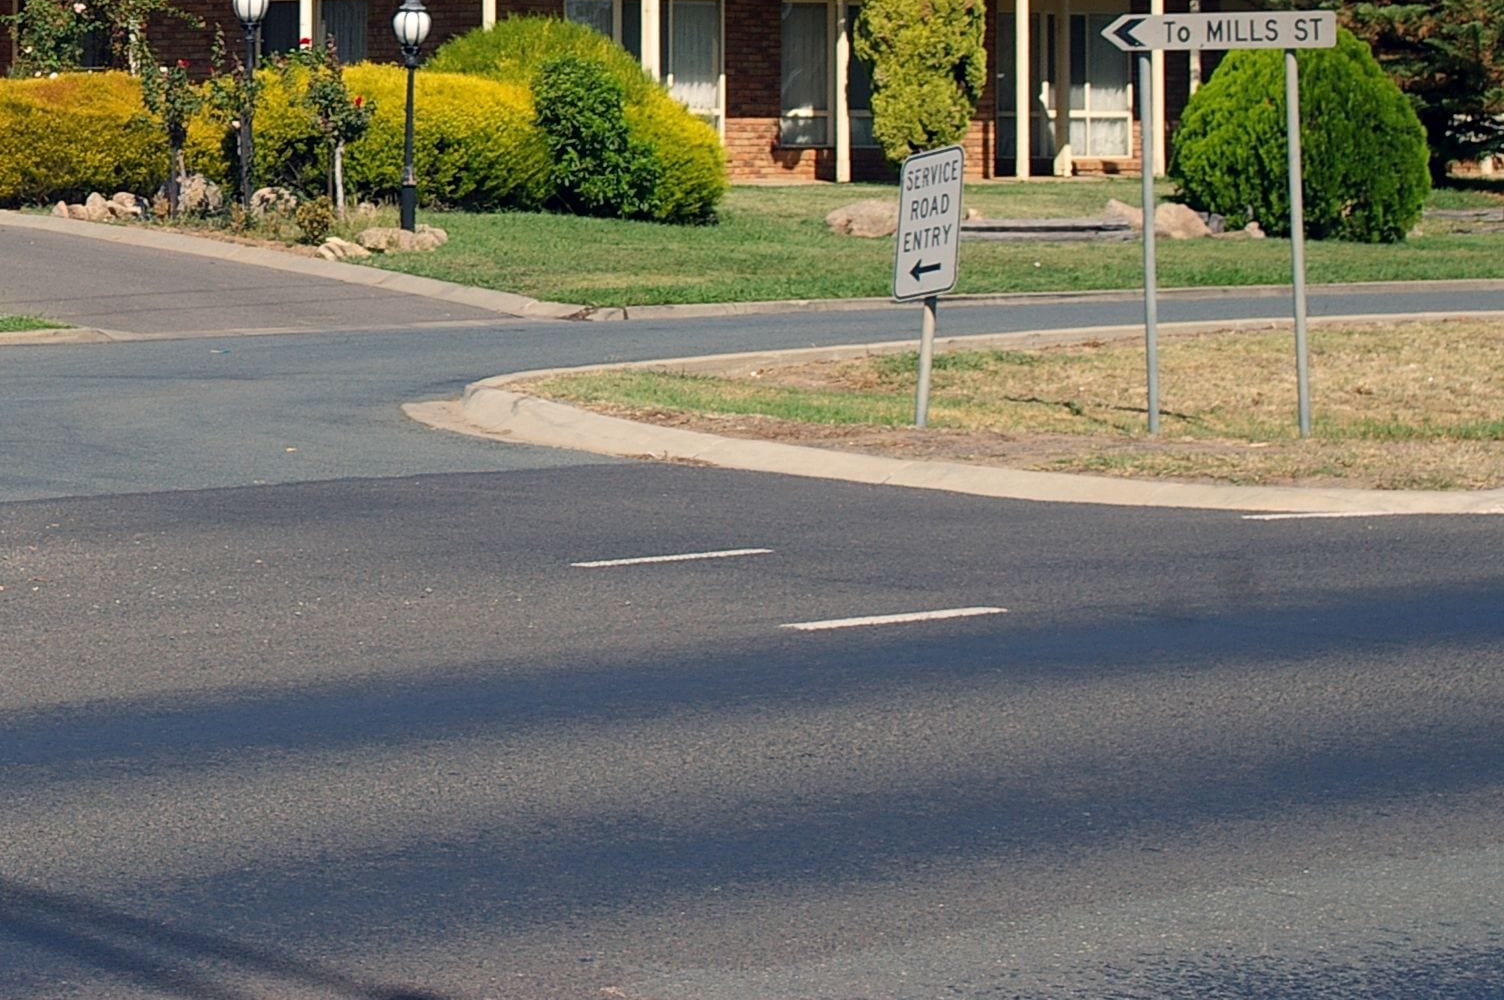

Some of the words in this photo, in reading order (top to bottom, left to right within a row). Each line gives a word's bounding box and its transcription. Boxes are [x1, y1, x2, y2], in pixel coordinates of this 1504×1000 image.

[1163, 21, 1190, 43] To
[1207, 19, 1278, 42] MILLS
[1294, 18, 1322, 41] ST
[906, 160, 959, 191] SERVICE
[910, 193, 950, 220] ROAD
[903, 223, 952, 253] ENTRY
